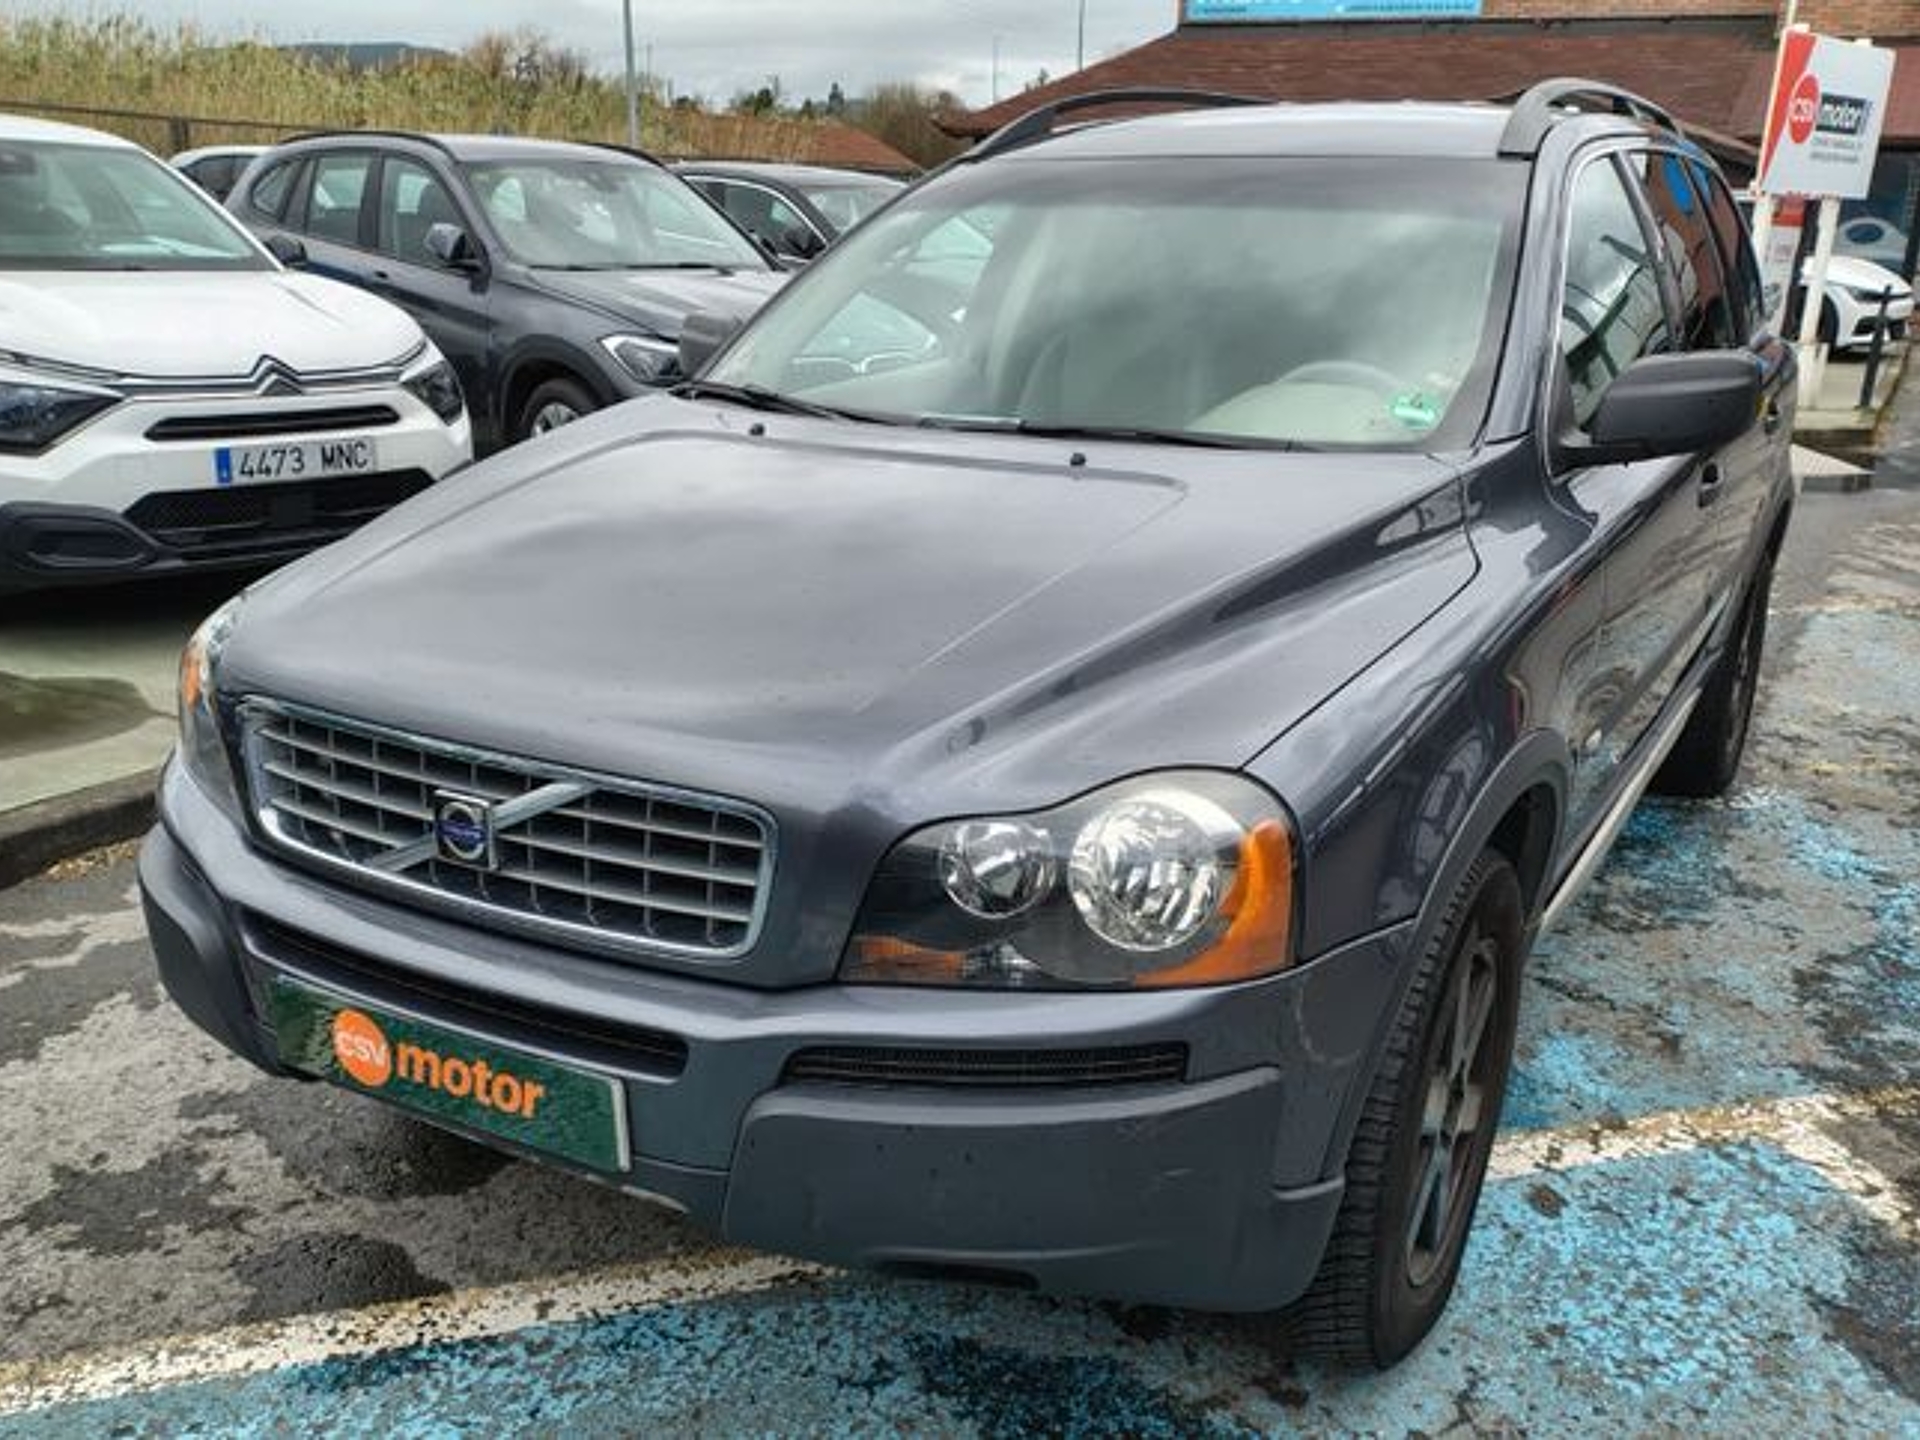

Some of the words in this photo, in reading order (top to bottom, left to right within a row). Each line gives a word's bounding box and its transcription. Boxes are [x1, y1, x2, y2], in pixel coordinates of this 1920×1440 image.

[1818, 100, 1862, 129] motor
[239, 447, 305, 478] 4473
[321, 440, 368, 470] MNC
[396, 1042, 546, 1119] motor
